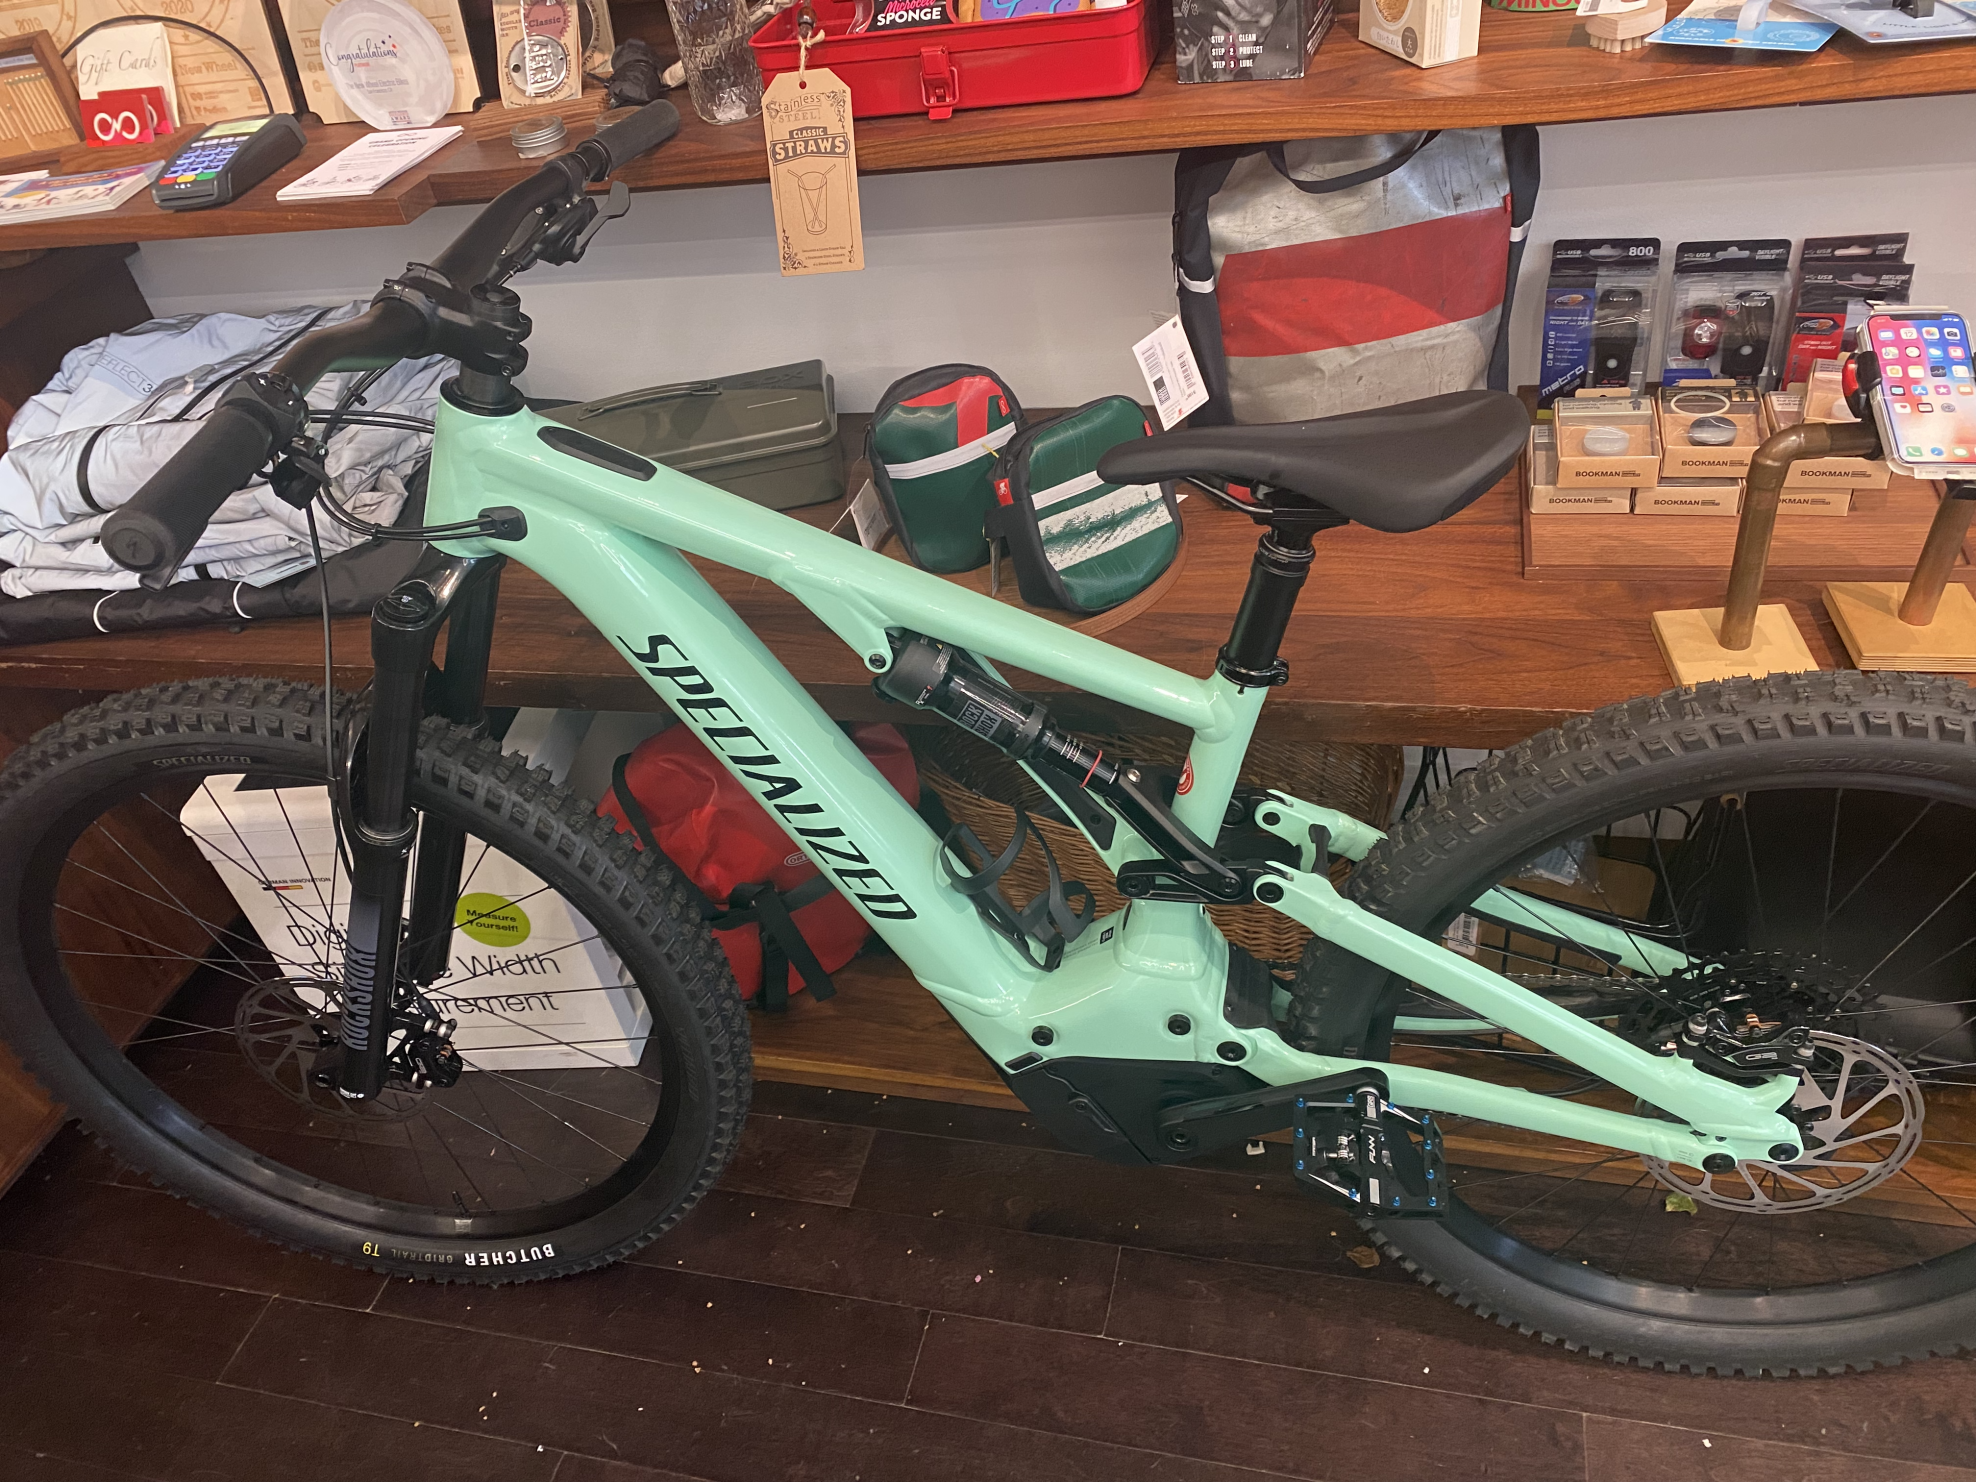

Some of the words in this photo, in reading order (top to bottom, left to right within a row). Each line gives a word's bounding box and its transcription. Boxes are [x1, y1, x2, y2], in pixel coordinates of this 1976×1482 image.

[161, 0, 194, 15] 2020
[528, 17, 561, 28] Classic
[876, 7, 942, 26] SPONGE
[1211, 35, 1225, 44] STEP
[1238, 33, 1257, 42] CLEAN
[324, 38, 397, 73] Congratulations
[1212, 48, 1226, 56] STEP
[1239, 46, 1263, 55] PROTECT
[80, 50, 112, 85] Gift
[119, 37, 160, 71] Cards
[202, 60, 238, 74] Wheel
[1212, 61, 1226, 69] STEP
[1239, 59, 1254, 68] LUBE
[765, 92, 821, 120] Stainless
[793, 128, 825, 138] CLASSIC
[774, 136, 846, 161] STRAWS
[1628, 246, 1654, 256] 800
[99, 354, 154, 394] EFLECT3
[1541, 365, 1585, 397] metro
[1575, 470, 1621, 478] BOOKMAN
[1800, 470, 1850, 478] BOOKMAN
[616, 634, 918, 920] SPECIALIZED
[466, 908, 517, 923] Measure
[466, 918, 519, 933] Yourself!
[286, 922, 347, 951] Digi
[456, 952, 561, 976] Width
[340, 942, 377, 1051] ROCKSHOX
[362, 1241, 380, 1258] T9
[464, 1243, 555, 1266] BUTCHER
